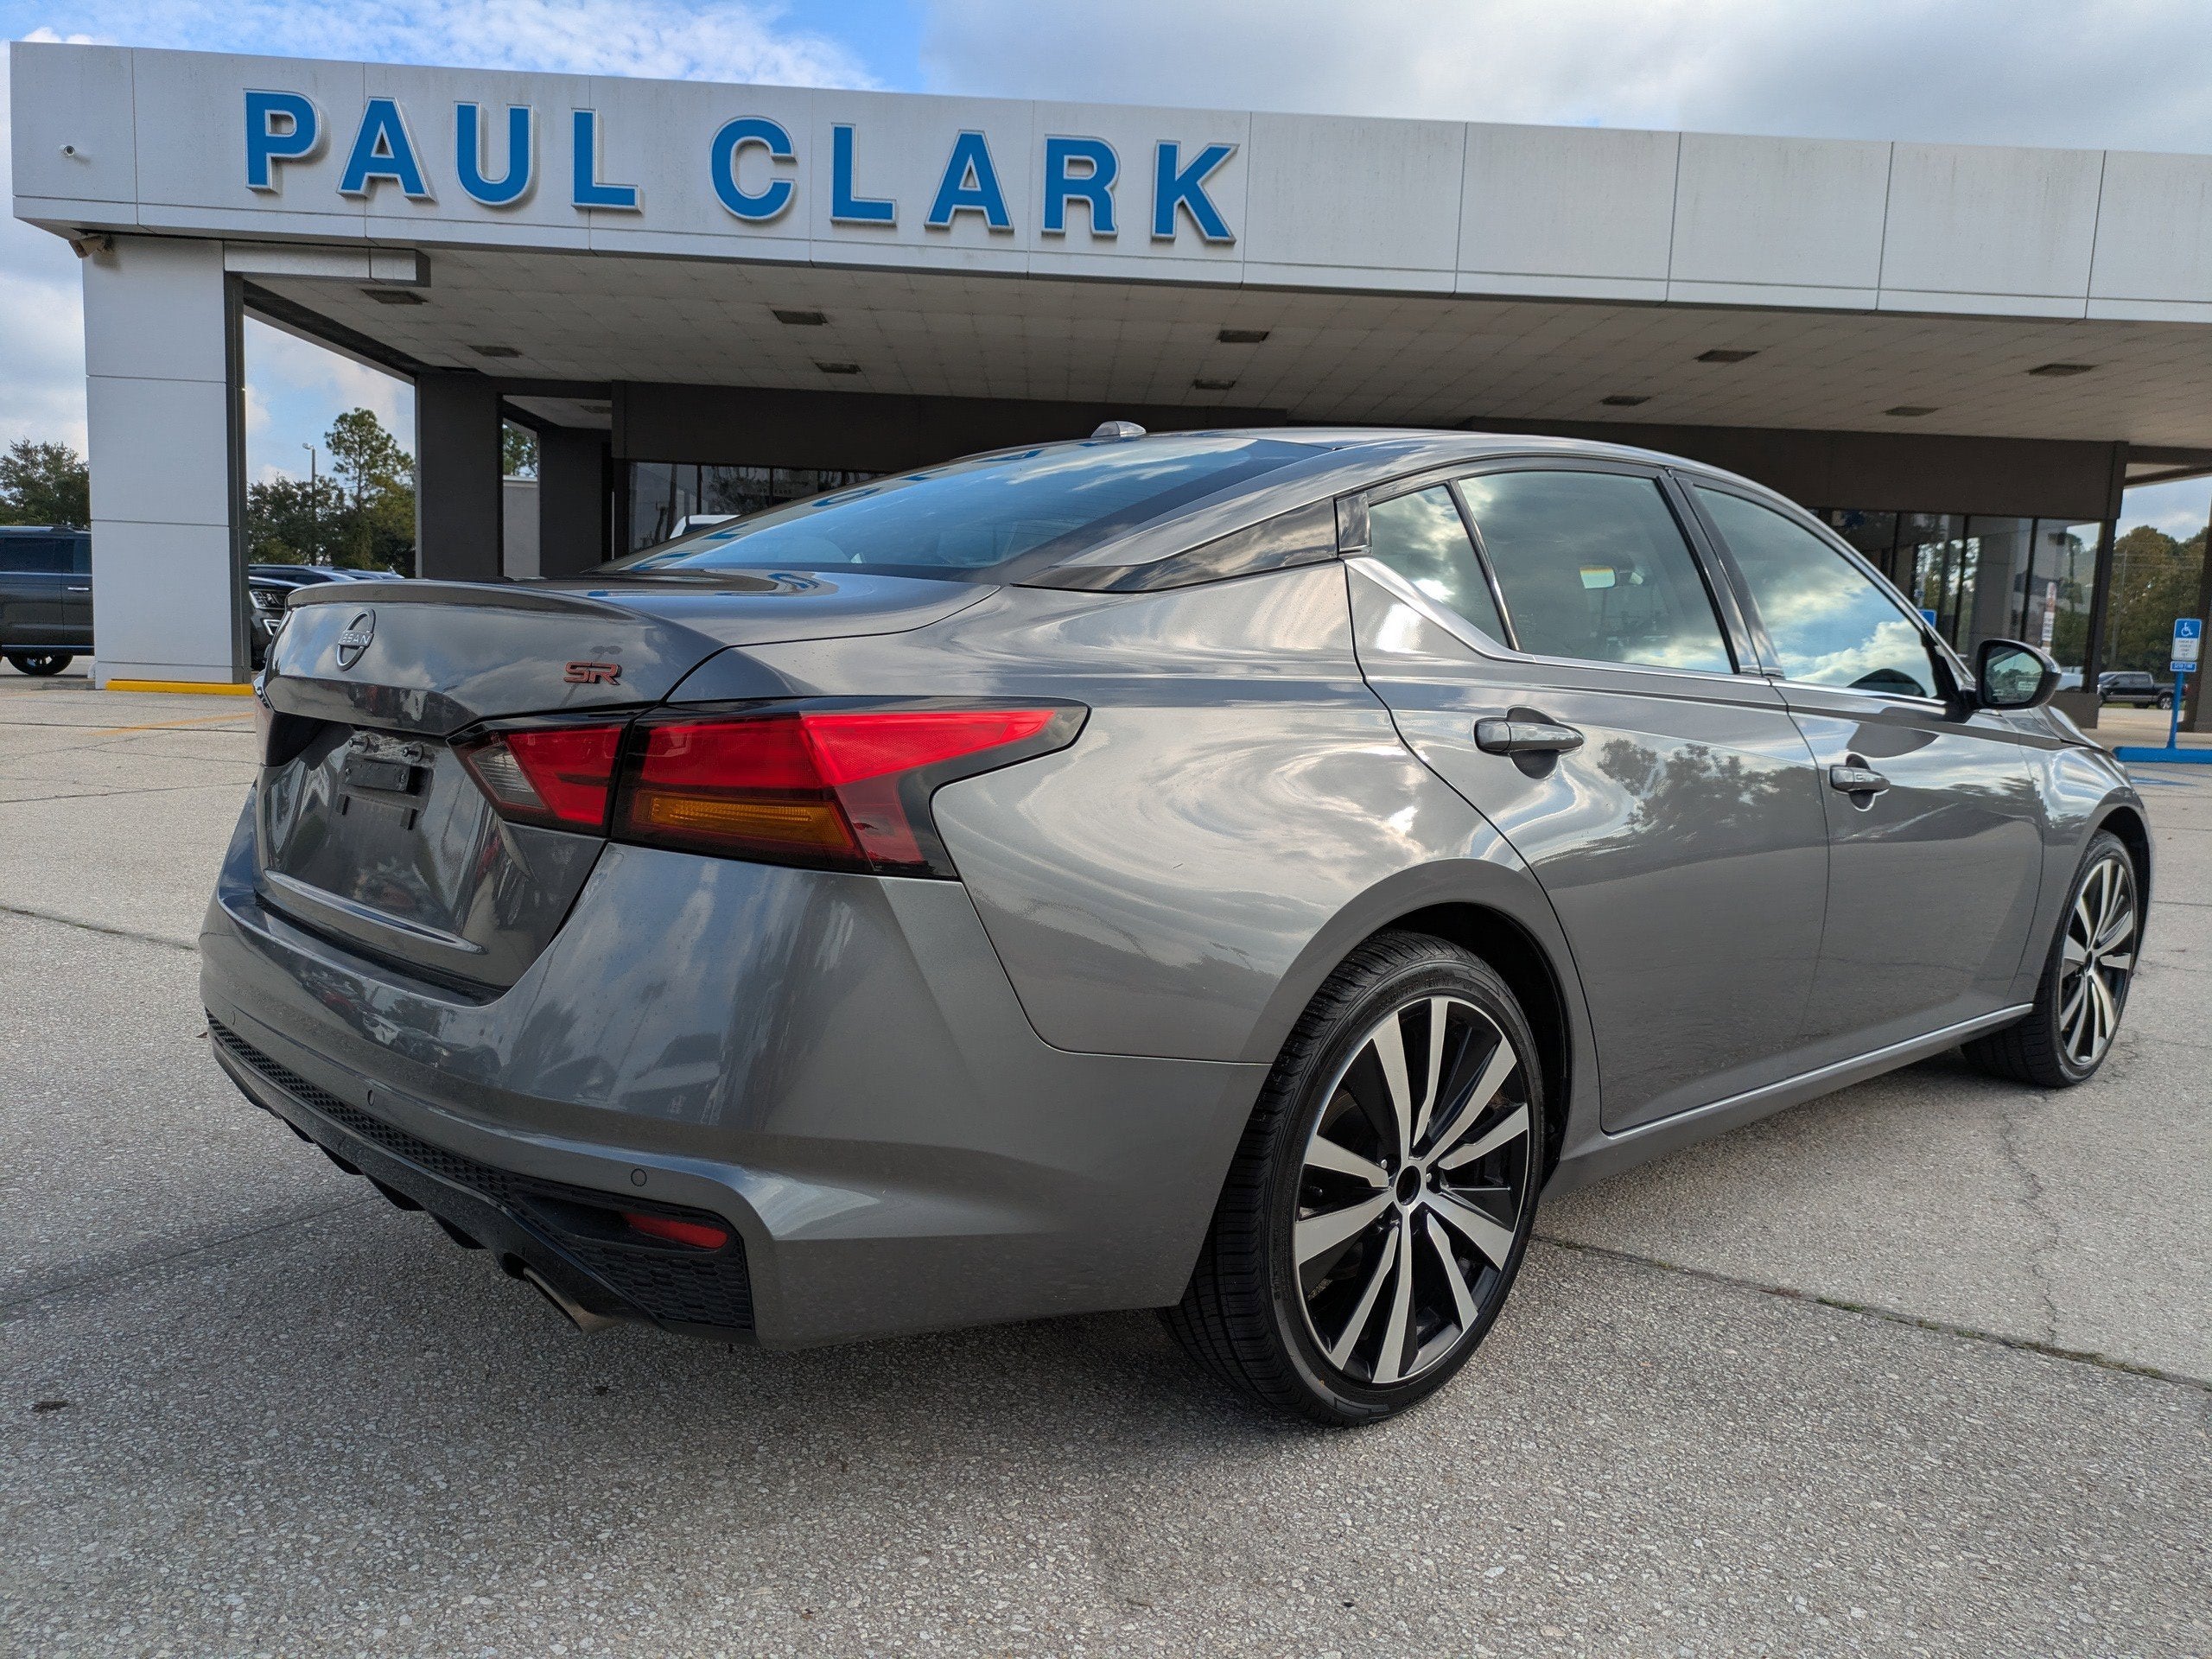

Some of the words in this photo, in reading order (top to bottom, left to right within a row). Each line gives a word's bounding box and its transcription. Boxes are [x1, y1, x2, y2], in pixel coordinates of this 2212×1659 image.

[243, 89, 642, 213] PAUL
[709, 115, 1240, 243] CLARK
[339, 632, 372, 645] SSAN
[563, 661, 621, 685] SR
